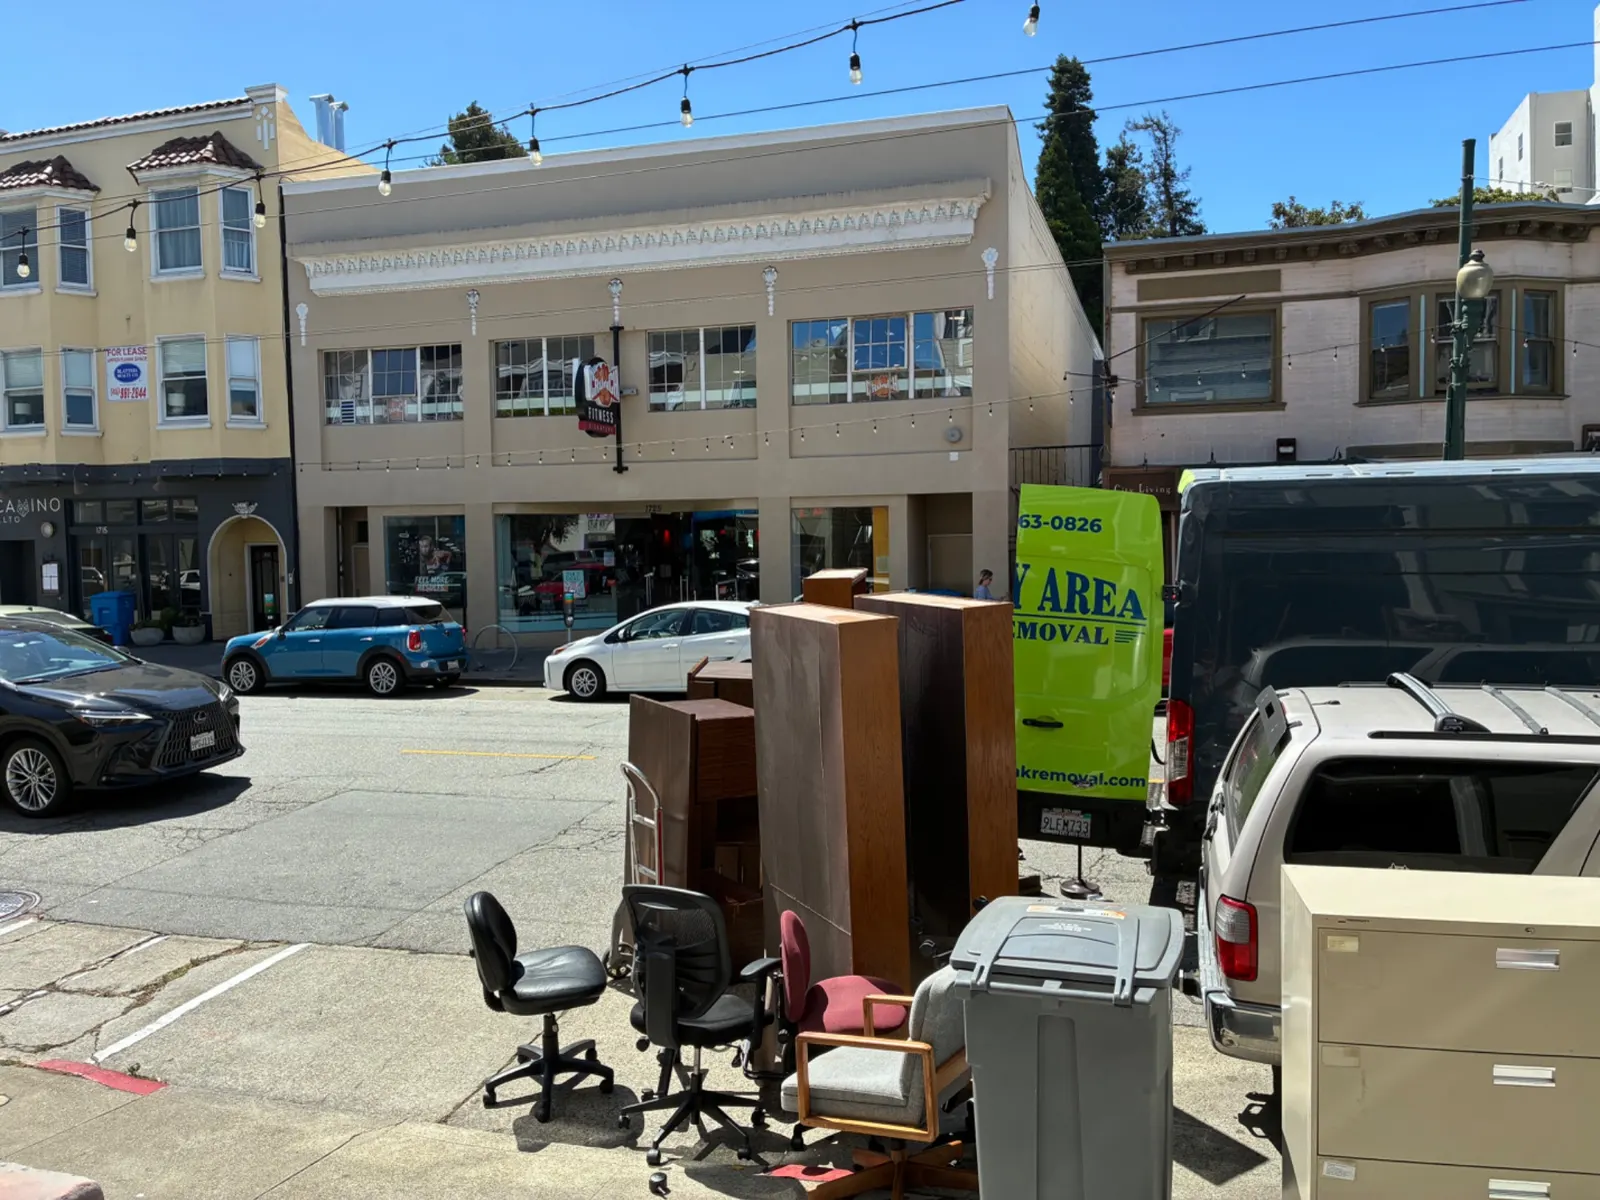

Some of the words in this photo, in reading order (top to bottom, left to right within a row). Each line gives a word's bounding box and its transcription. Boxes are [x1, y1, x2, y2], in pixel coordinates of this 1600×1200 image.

[107, 348, 122, 357] FOR
[123, 347, 147, 356] LEASE
[588, 407, 614, 423] FITNESS
[1138, 483, 1171, 495] Living
[0, 515, 21, 524] LTO
[1018, 514, 1102, 533] 63-0826
[1037, 567, 1147, 620] AREA
[1012, 621, 1109, 645] MOVAL
